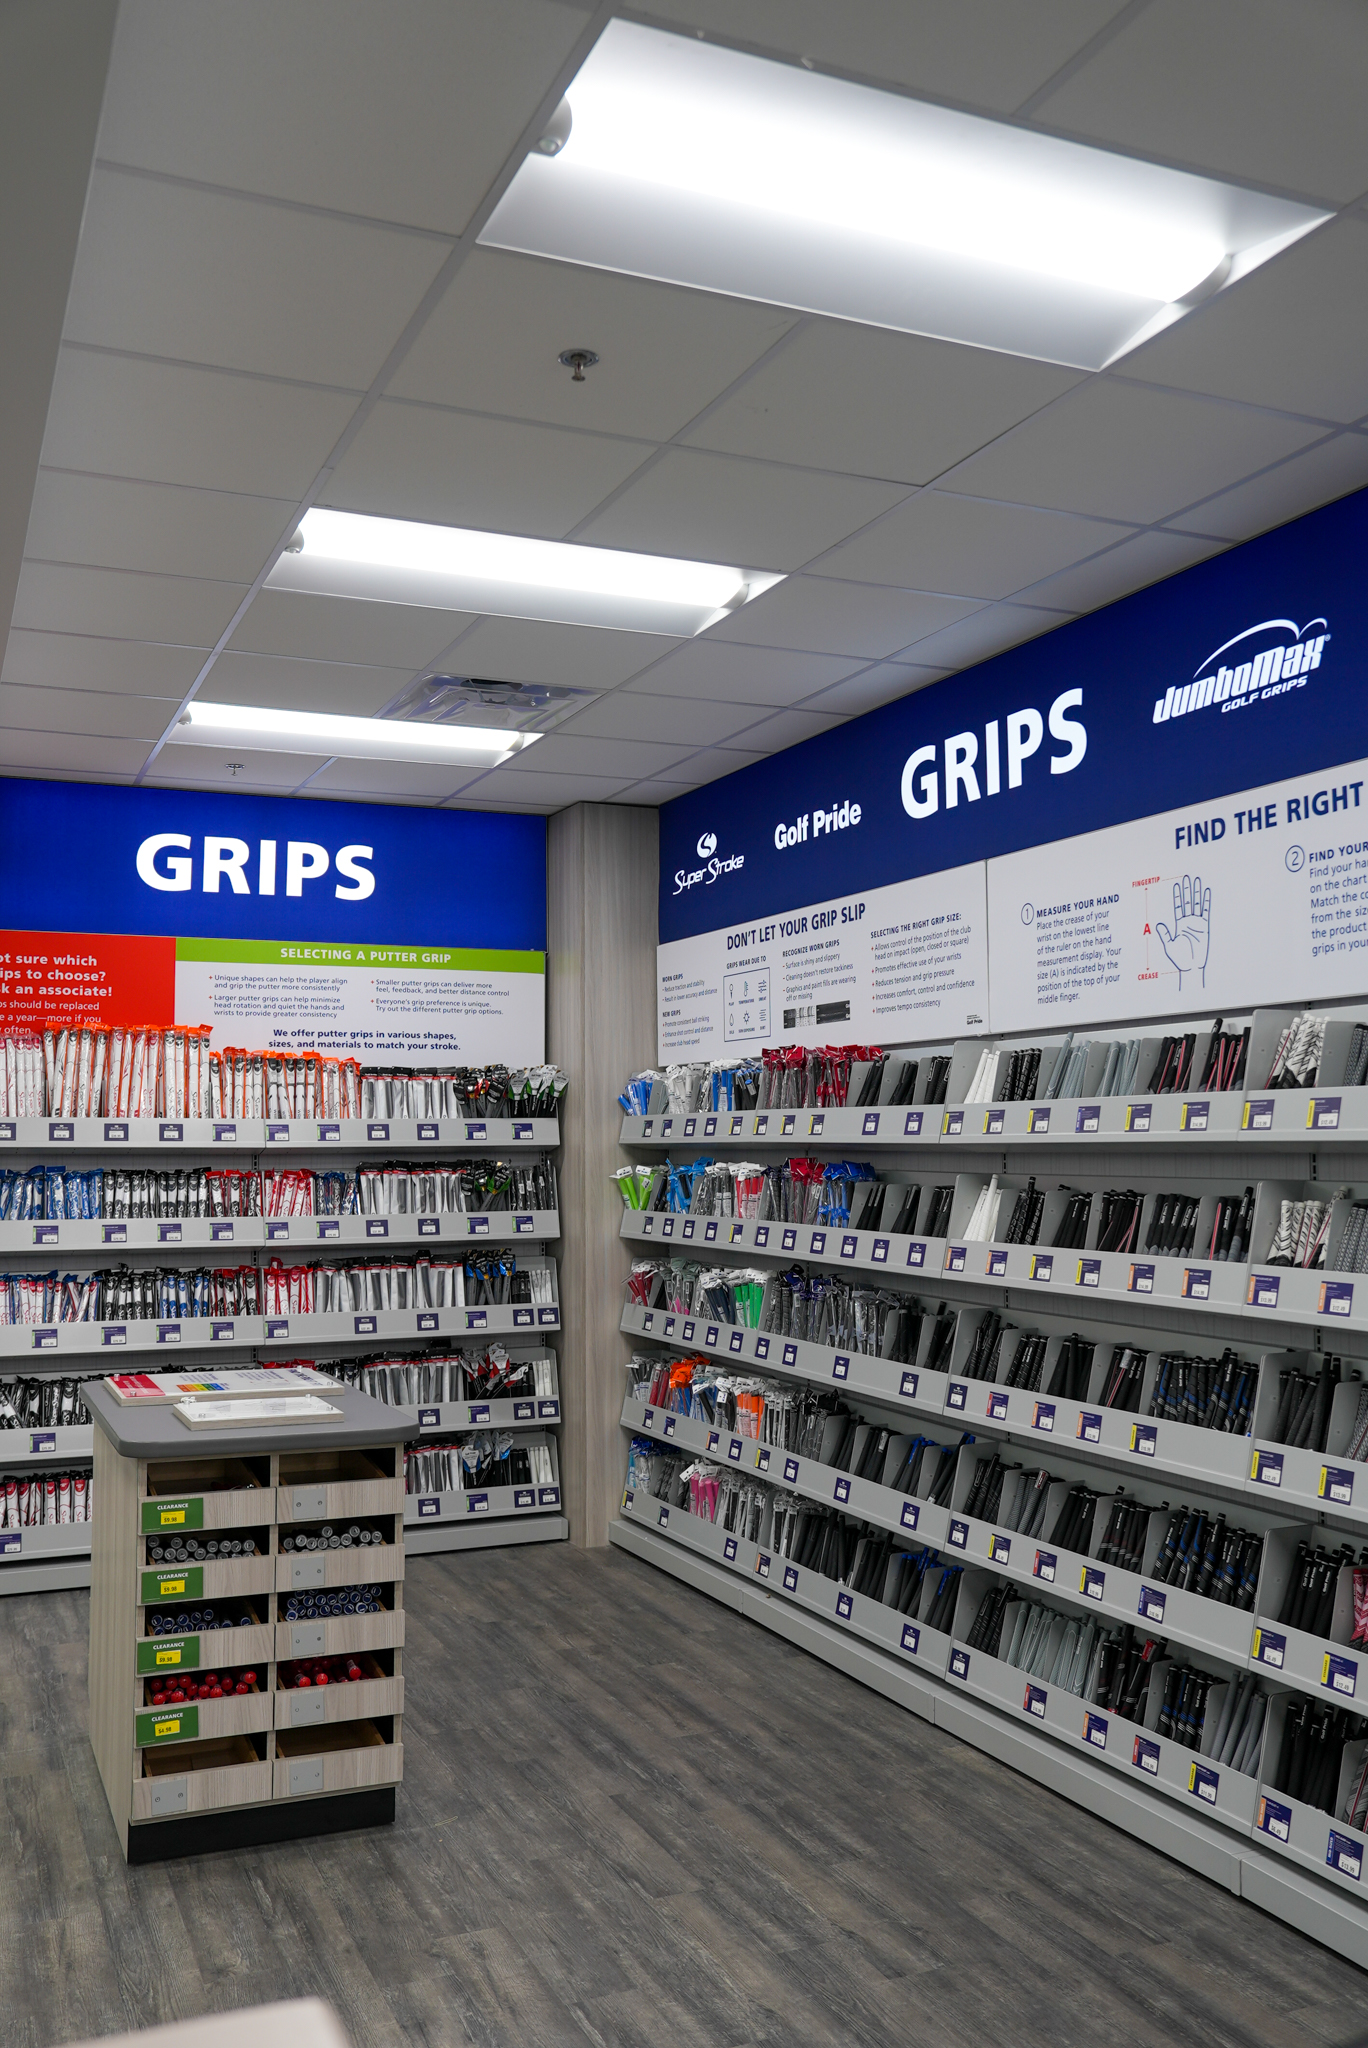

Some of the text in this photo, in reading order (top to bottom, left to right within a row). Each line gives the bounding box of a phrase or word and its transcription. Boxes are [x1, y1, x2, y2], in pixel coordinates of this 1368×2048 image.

[1221, 675, 1308, 713] GOLF GRIPS
[900, 688, 1088, 819] GRIPS
[1175, 782, 1364, 848] FIND THE RIGHT
[774, 804, 862, 850] Golf Pride
[1309, 843, 1368, 862] FIND YOUR
[136, 833, 376, 900] GRIPS
[1309, 865, 1329, 878] Find
[1331, 863, 1352, 876] your
[1132, 876, 1160, 887] FINGERTIP
[1310, 875, 1367, 894] on the chart
[1036, 894, 1120, 917] MEASURE YOUR HAND
[1310, 895, 1339, 908] Match
[1341, 893, 1358, 903] the
[1036, 910, 1110, 930] Place the crease of your
[1311, 913, 1333, 923] from
[1335, 909, 1352, 920] the
[727, 905, 866, 950] DON'T LET YOUR GRIP SLIP
[870, 913, 962, 938] SELECTING THE RIGHT GRIP SIZE:
[1036, 934, 1052, 942] wrist
[1062, 930, 1073, 938] the
[1074, 926, 1096, 936] lowest
[1097, 923, 1110, 931] line
[1143, 923, 1151, 935] A
[1311, 922, 1367, 939] the product
[782, 939, 840, 957] RECOGNIZE WORN GRIPS
[1036, 946, 1044, 955] of
[1044, 945, 1056, 954] the
[1056, 943, 1072, 952] ruler
[1082, 939, 1094, 947] the
[1094, 935, 1112, 945] hand
[1312, 943, 1335, 957] grips
[1337, 941, 1346, 950] in
[16, 956, 48, 964] sure
[53, 955, 97, 966] which
[280, 948, 451, 963] SELECTING A PUTTER GRIP
[1037, 948, 1122, 966] measurement display. Your
[26, 969, 42, 979] to
[47, 970, 106, 981] choose?
[1037, 961, 1118, 980] size (A) is indicated by the
[1138, 972, 1158, 980] CREASE
[214, 975, 240, 983] Unique
[1037, 974, 1120, 993] position of the top of your
[15, 986, 33, 994] an
[38, 986, 112, 996] associate!
[1037, 993, 1080, 1004] middle finger.
[9, 1000, 42, 1009] should
[44, 1001, 57, 1009] be
[59, 1002, 100, 1011] replaced
[375, 998, 410, 1006] Everyone's
[876, 1006, 897, 1014] Improves
[913, 1000, 941, 1008] consistency
[74, 1014, 82, 1022] if
[83, 1016, 102, 1025] you
[4, 1025, 34, 1035] often.
[350, 1031, 374, 1039] grips
[423, 1032, 457, 1040] shapes,
[268, 1040, 294, 1048] sizes,
[153, 1642, 185, 1650] CLEARANCE
[151, 1712, 183, 1722] CLEARANCE
